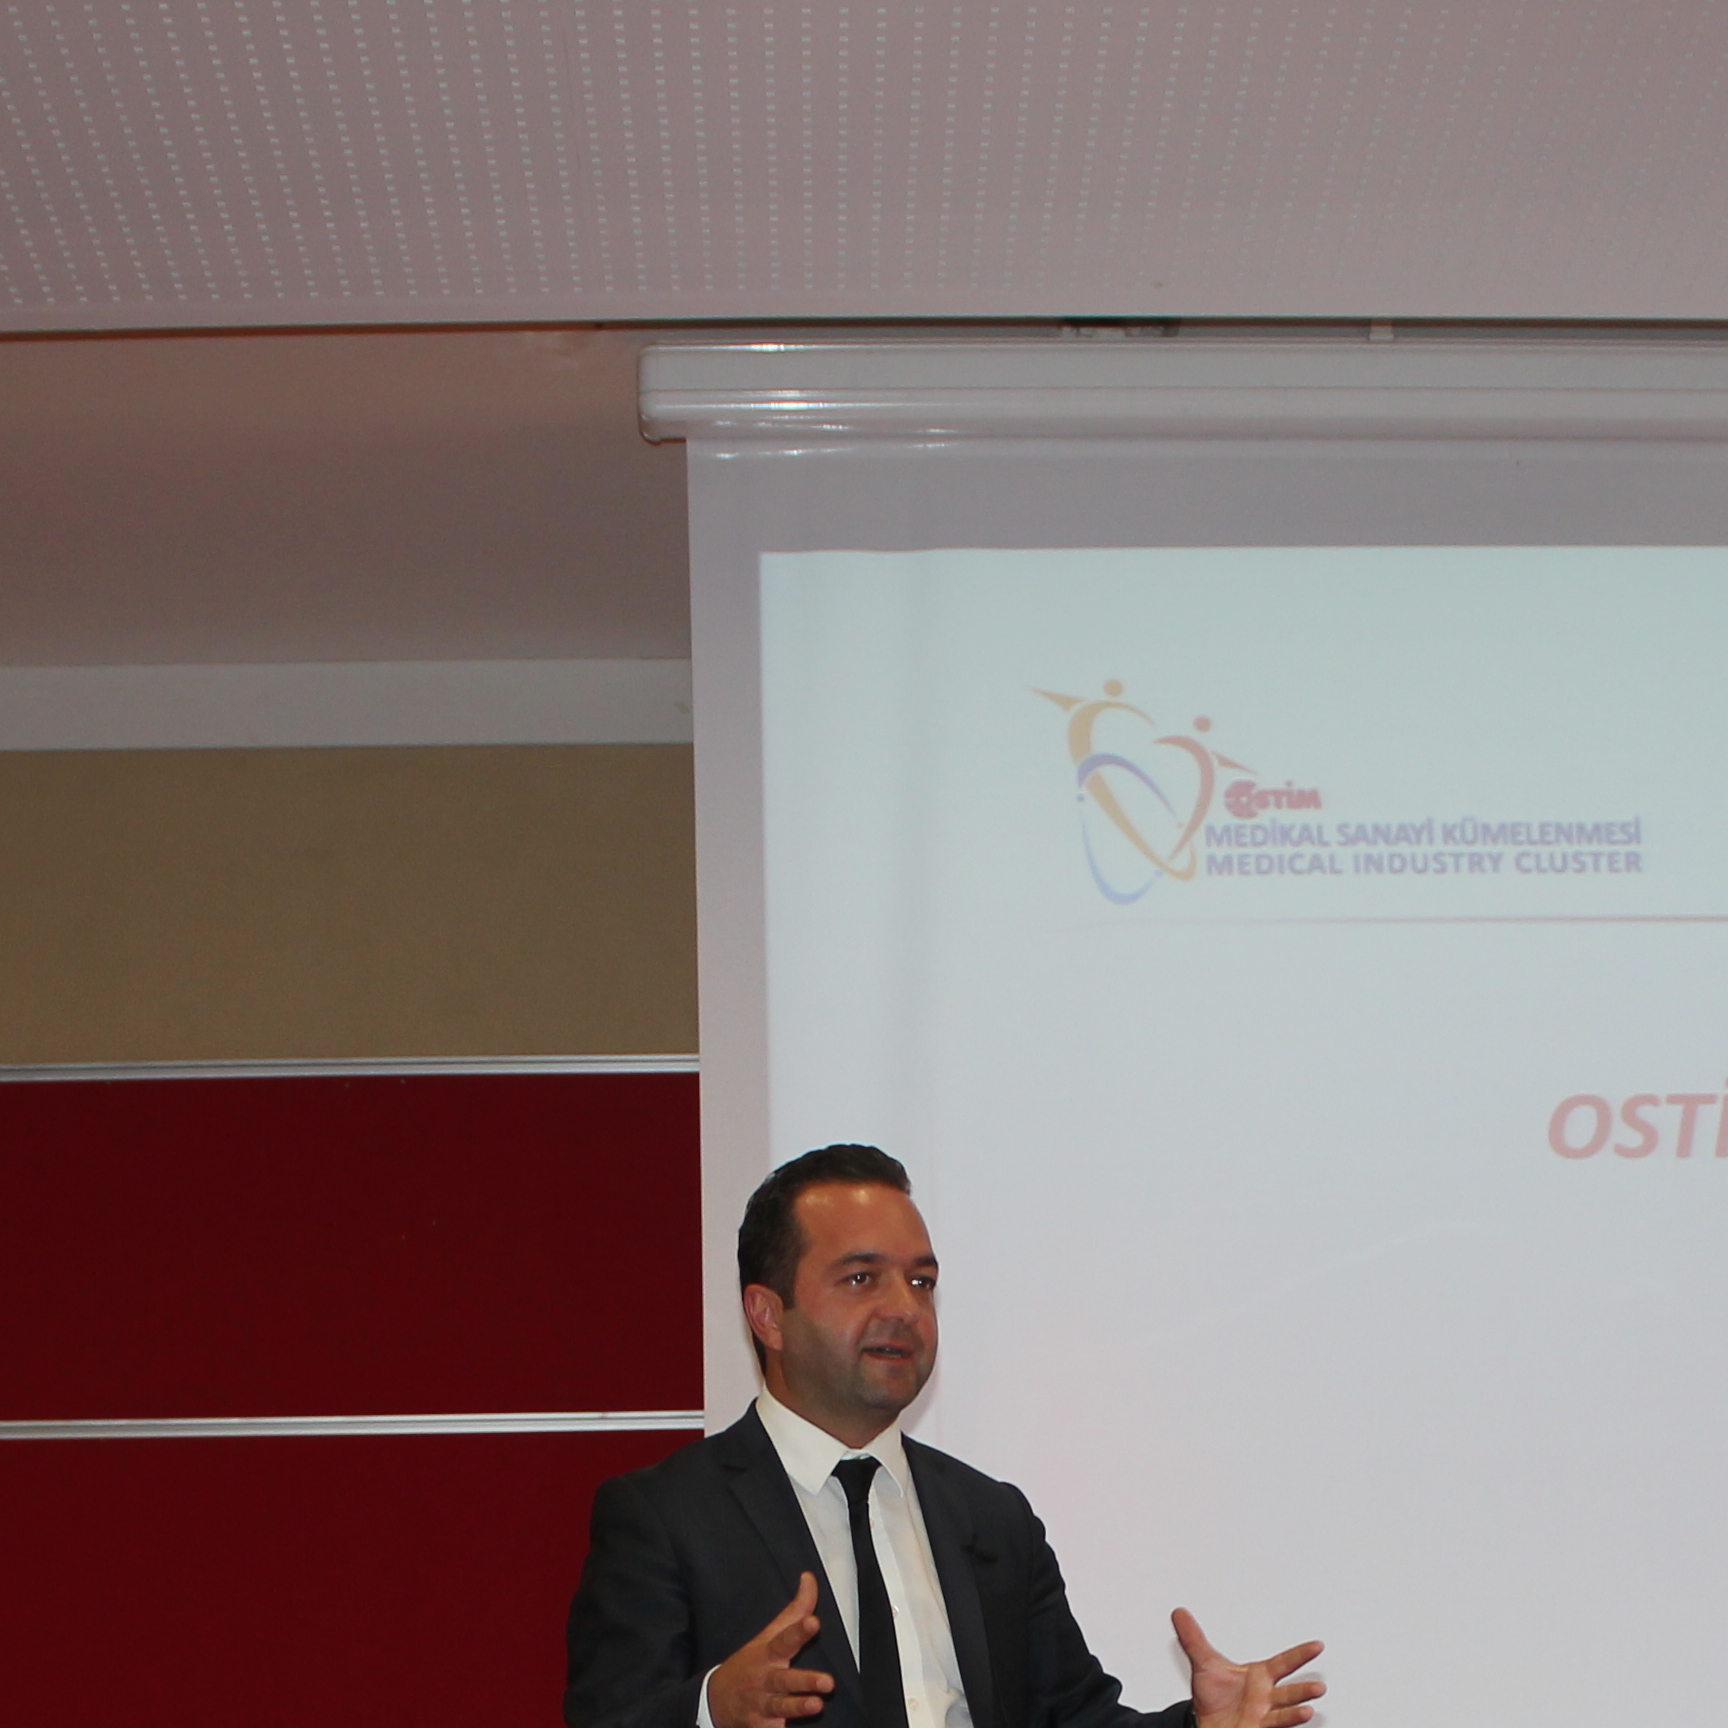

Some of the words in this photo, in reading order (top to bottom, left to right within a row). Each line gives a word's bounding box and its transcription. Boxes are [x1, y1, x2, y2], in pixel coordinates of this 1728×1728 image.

[1205, 817, 1331, 848] MEDİKAL
[1336, 816, 1435, 847] SANAYİ
[1441, 814, 1642, 846] KÜMELENMESİ
[1206, 852, 1347, 876] MEDICAL
[1353, 851, 1503, 875] INDUSTRY
[1514, 850, 1643, 874] CLUSTER
